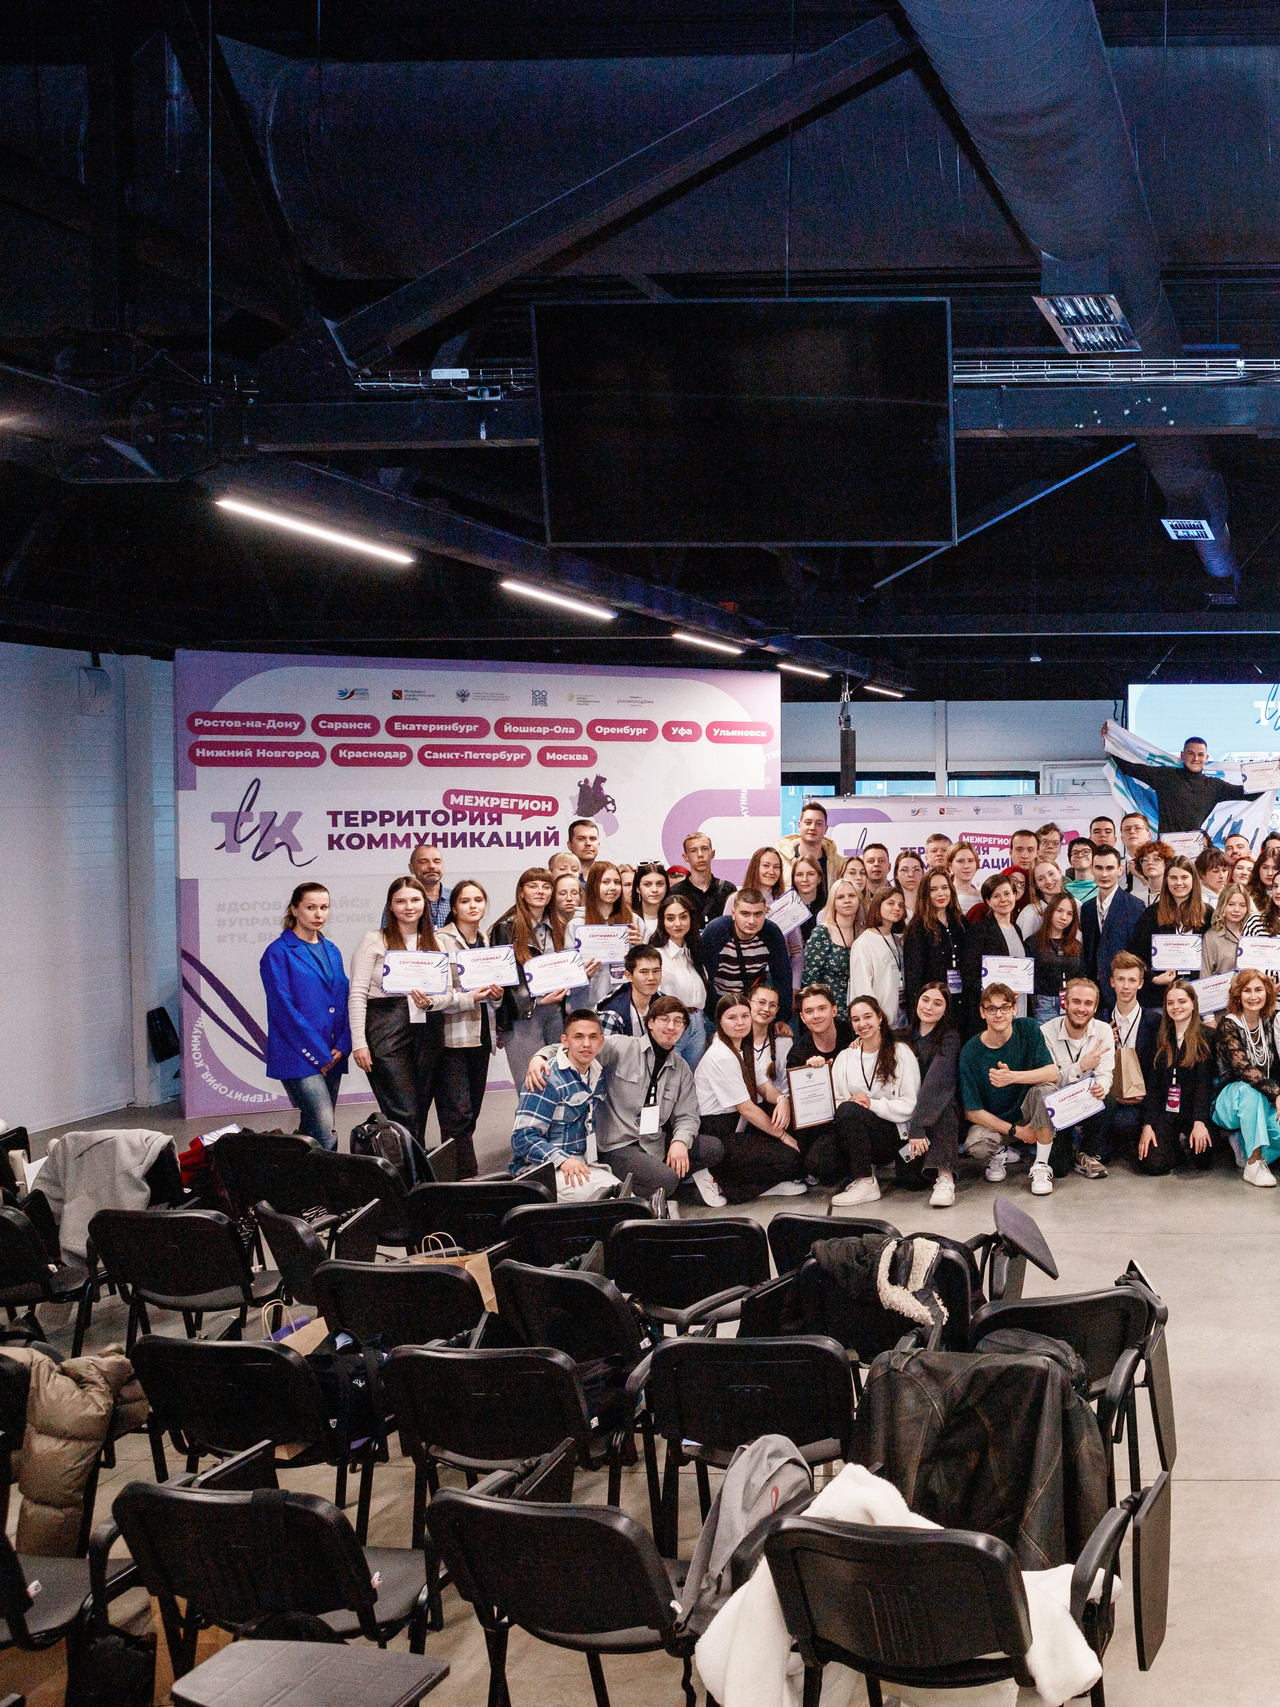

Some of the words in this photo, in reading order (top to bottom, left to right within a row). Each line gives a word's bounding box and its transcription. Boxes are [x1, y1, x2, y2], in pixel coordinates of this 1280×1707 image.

[194, 717, 301, 732] Ростов-на-Дону
[318, 719, 372, 731] Саранск
[394, 721, 479, 734] Екатеринбург
[503, 723, 575, 735] Йошкар-Ола
[594, 725, 649, 736] Оренбург
[671, 726, 693, 737] Уфа
[712, 728, 768, 738] Ульяновск
[195, 748, 253, 758] Нижний
[256, 749, 320, 760] Новгород
[338, 749, 407, 761] Краснодар
[423, 750, 527, 762] Санкт-Петербург
[546, 752, 589, 761] Москва
[449, 793, 553, 812] МЕЖРЕГИОН
[326, 809, 503, 828] ТЕРРИТОРИЯ
[327, 826, 560, 851] КОММУНИКАЦИЙ
[471, 955, 502, 963] СЕРТИФИКАТ
[1202, 979, 1229, 991] СЕРТИФИКАТ
